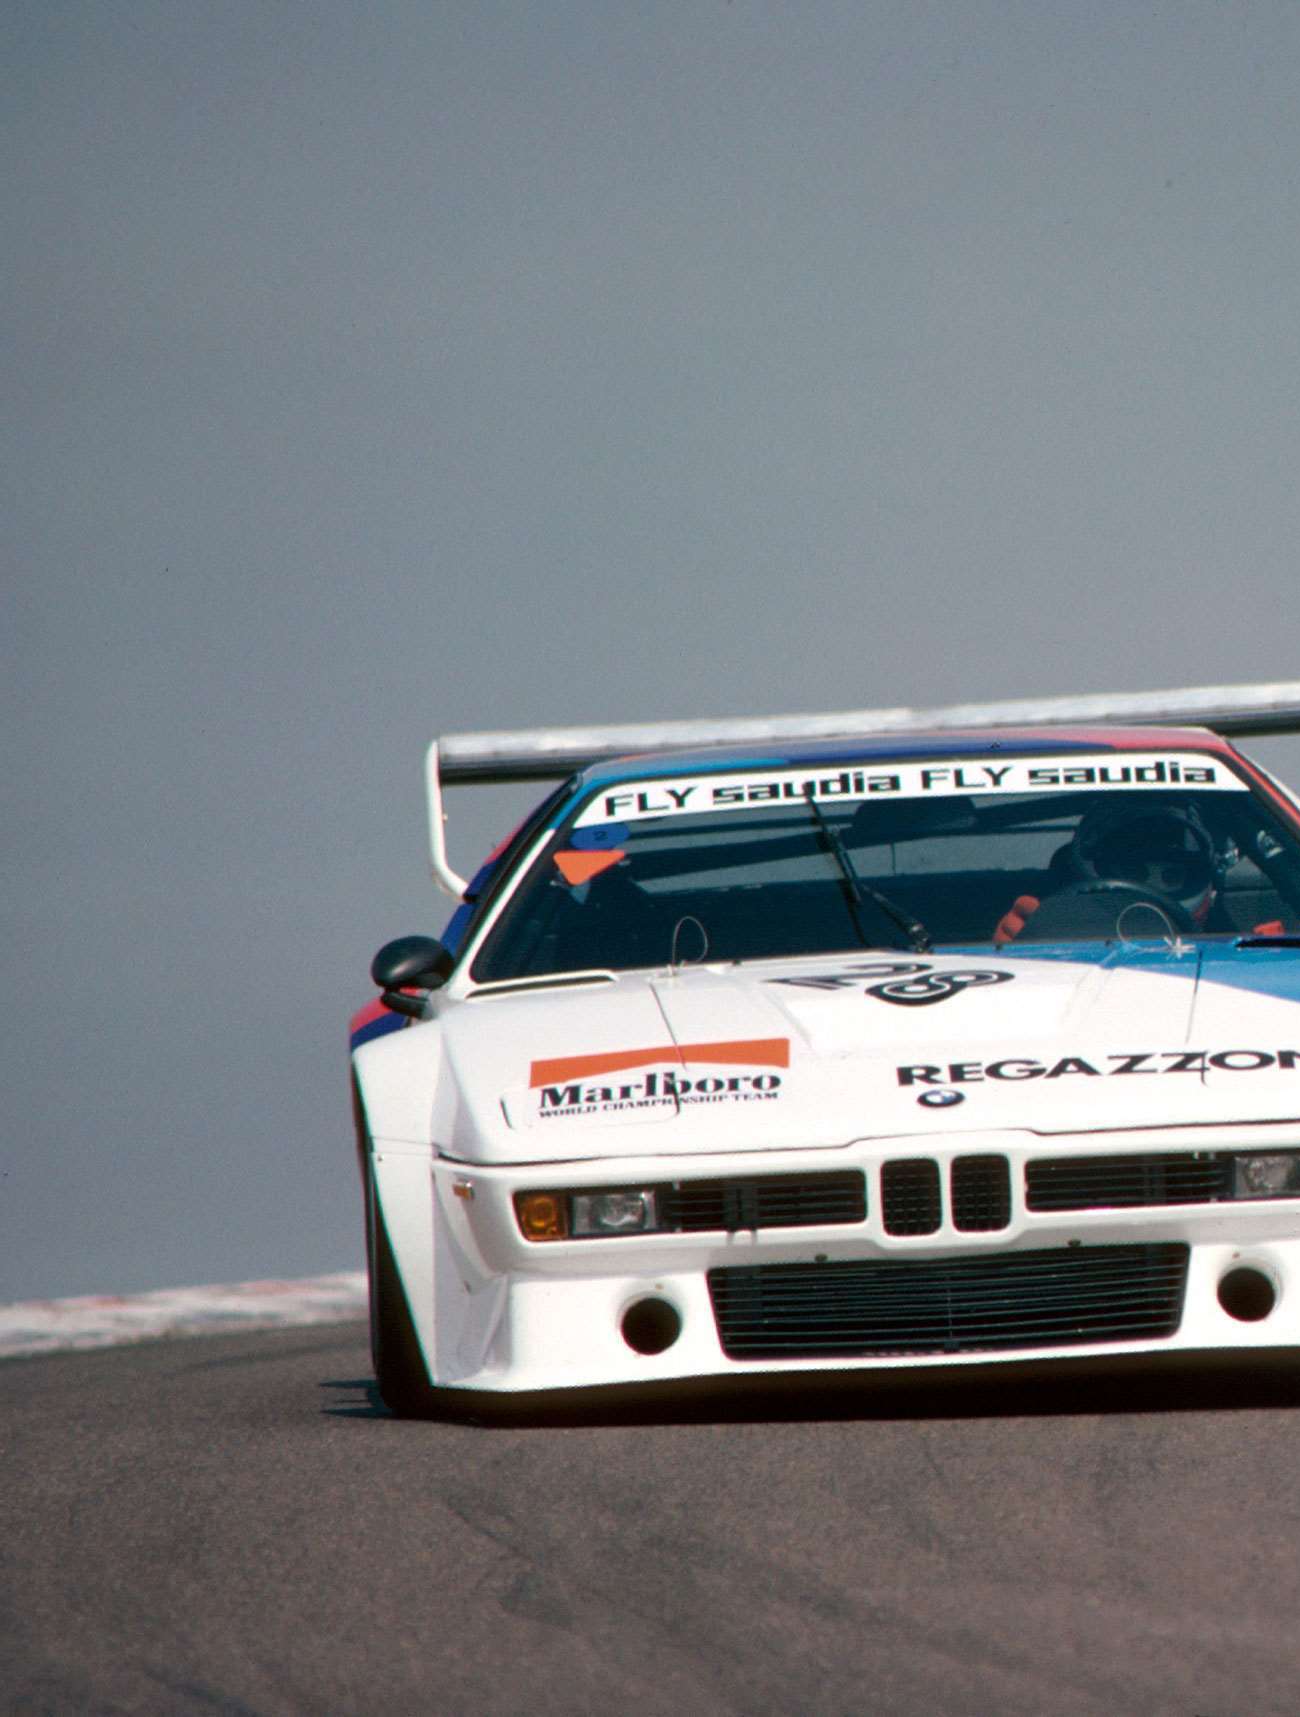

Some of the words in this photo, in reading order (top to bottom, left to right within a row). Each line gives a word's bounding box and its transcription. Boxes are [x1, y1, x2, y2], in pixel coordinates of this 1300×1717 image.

[605, 787, 698, 818] FLY
[711, 771, 901, 803] saudia
[920, 764, 1015, 791] FLY
[1027, 761, 1217, 785] saudia
[538, 1072, 781, 1109] Marlboro
[539, 1103, 598, 1118] WORLD
[731, 1091, 779, 1101] TEAM
